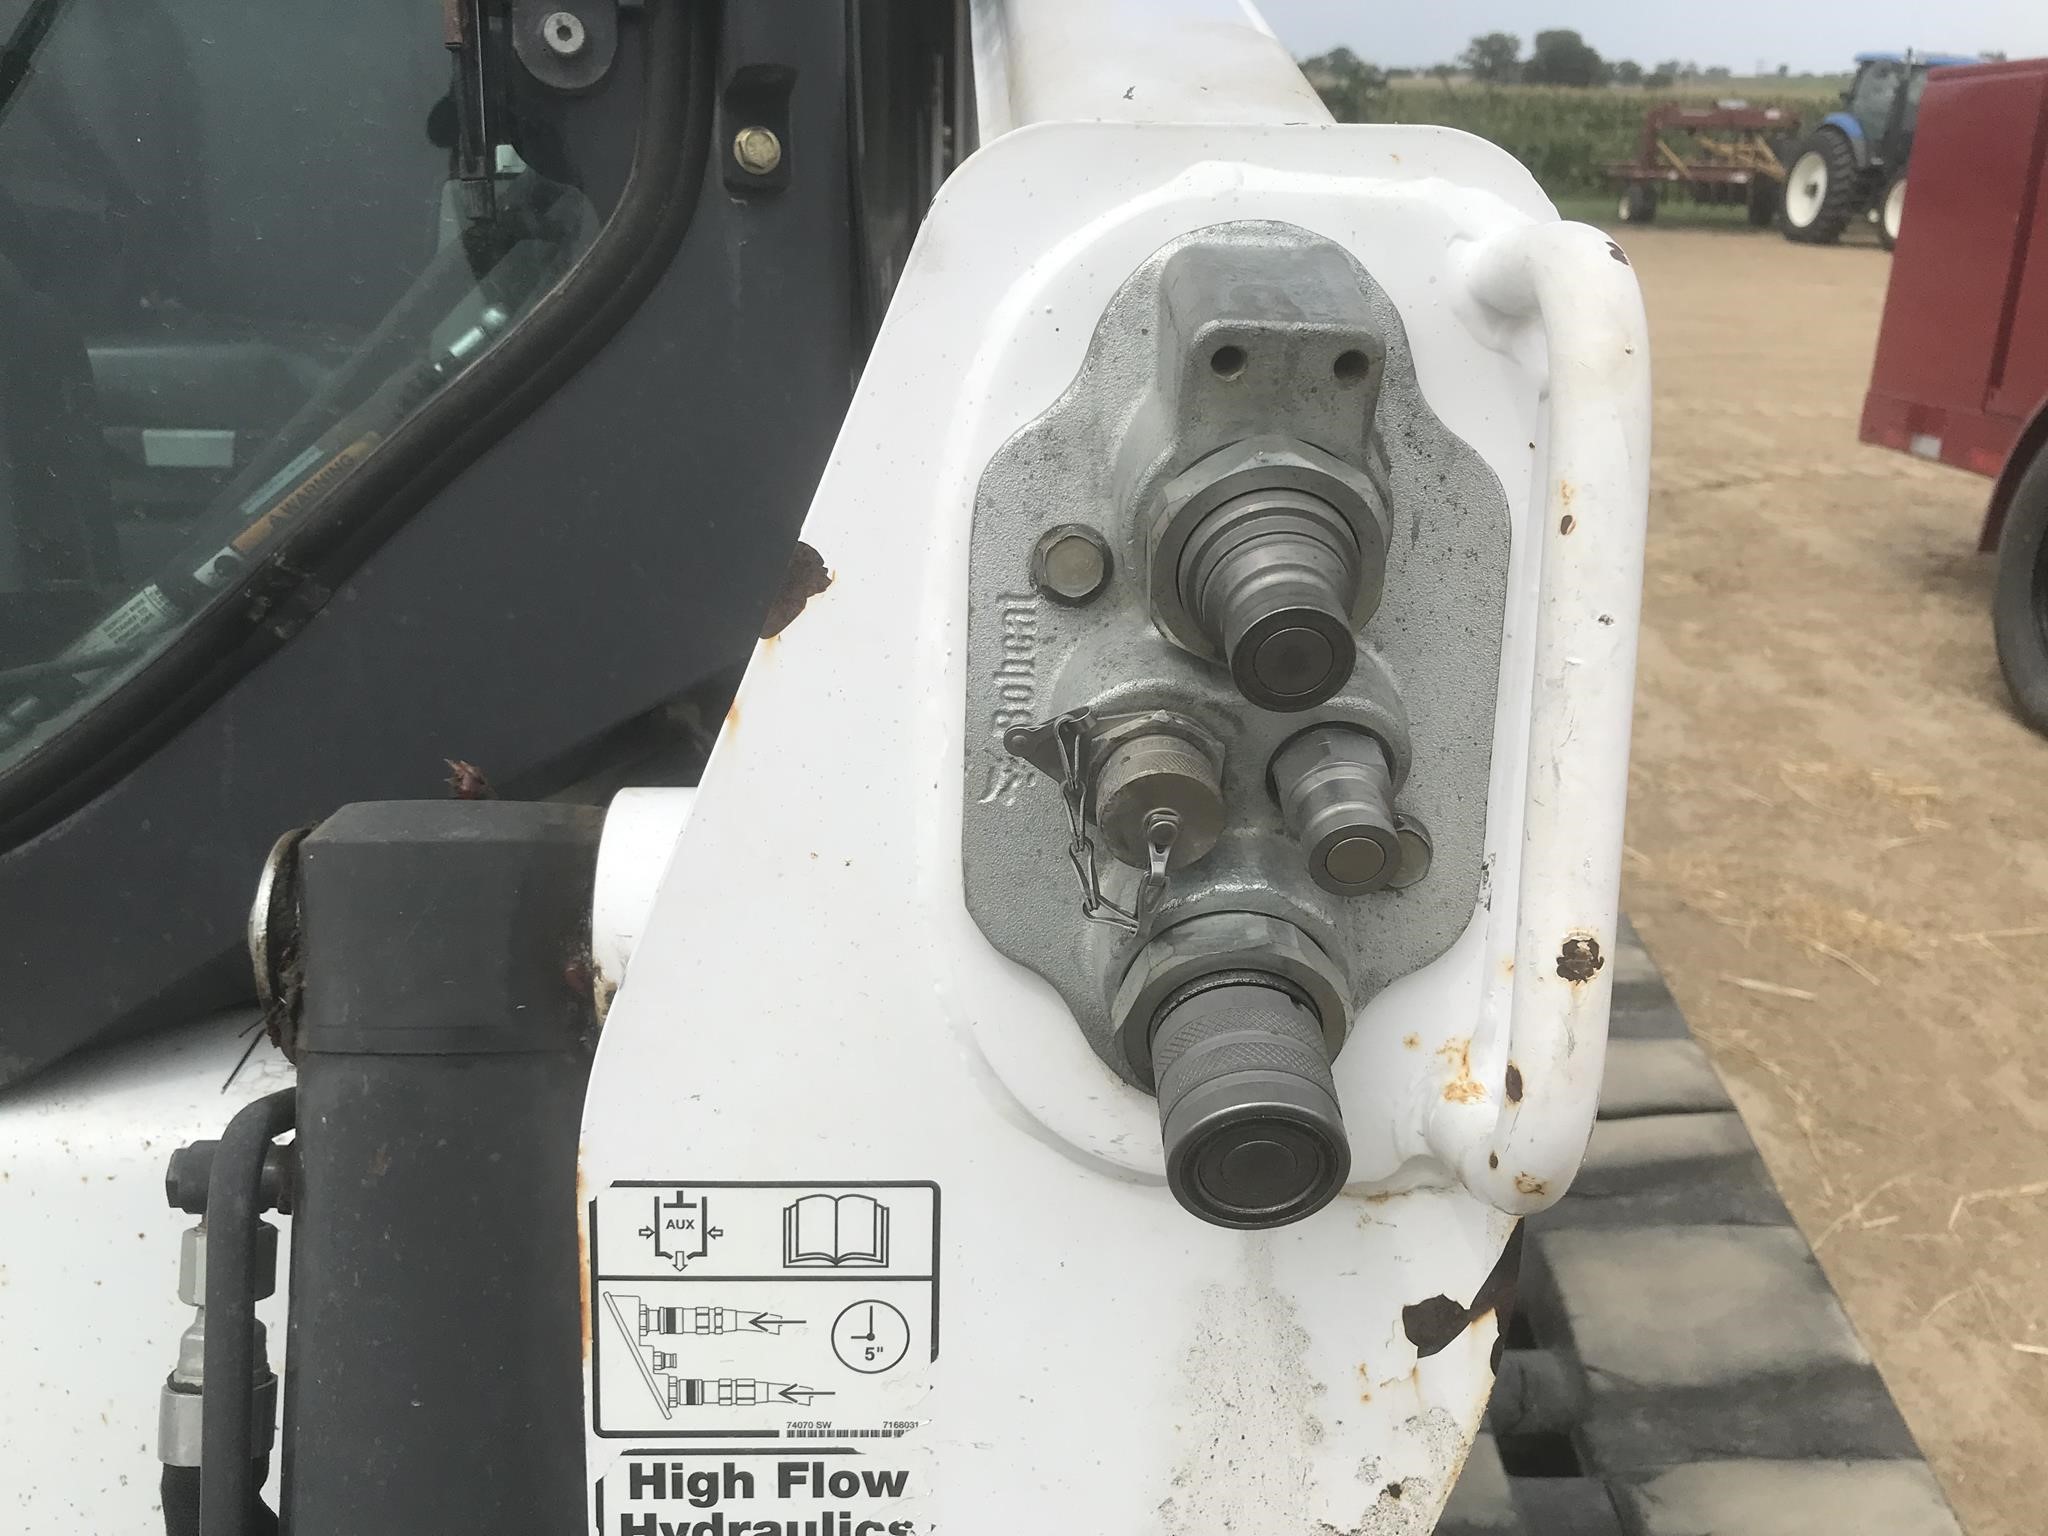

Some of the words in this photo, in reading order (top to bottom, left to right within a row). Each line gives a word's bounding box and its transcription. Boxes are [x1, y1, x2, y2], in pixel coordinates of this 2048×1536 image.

[666, 1219, 695, 1230] AUX
[786, 1421, 814, 1429] 74070
[816, 1421, 832, 1429] SW
[883, 1421, 919, 1429] 7168031
[629, 1462, 755, 1508] High
[778, 1461, 909, 1498] Flow
